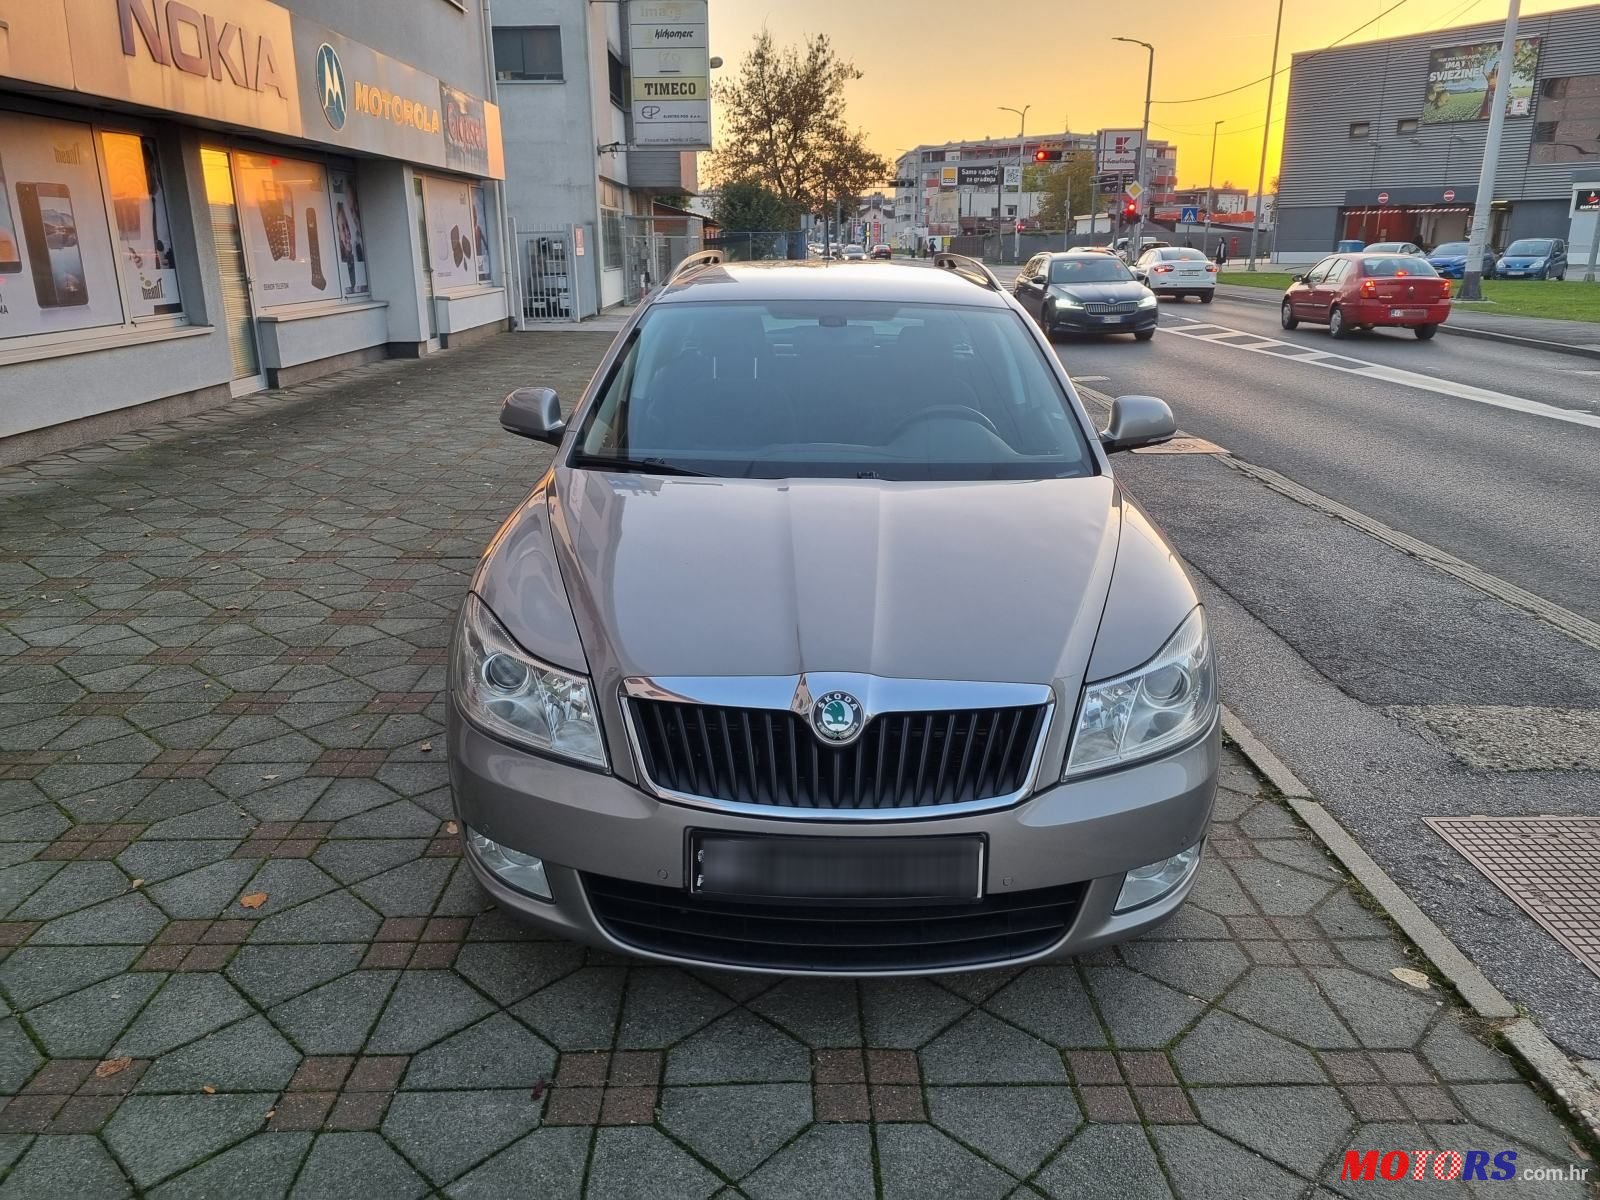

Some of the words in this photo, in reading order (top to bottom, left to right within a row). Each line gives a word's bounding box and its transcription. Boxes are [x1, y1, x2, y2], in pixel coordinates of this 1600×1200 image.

[116, 0, 288, 100] NOKIA
[354, 80, 440, 135] MOTOROLA
[644, 82, 696, 96] TIMECO
